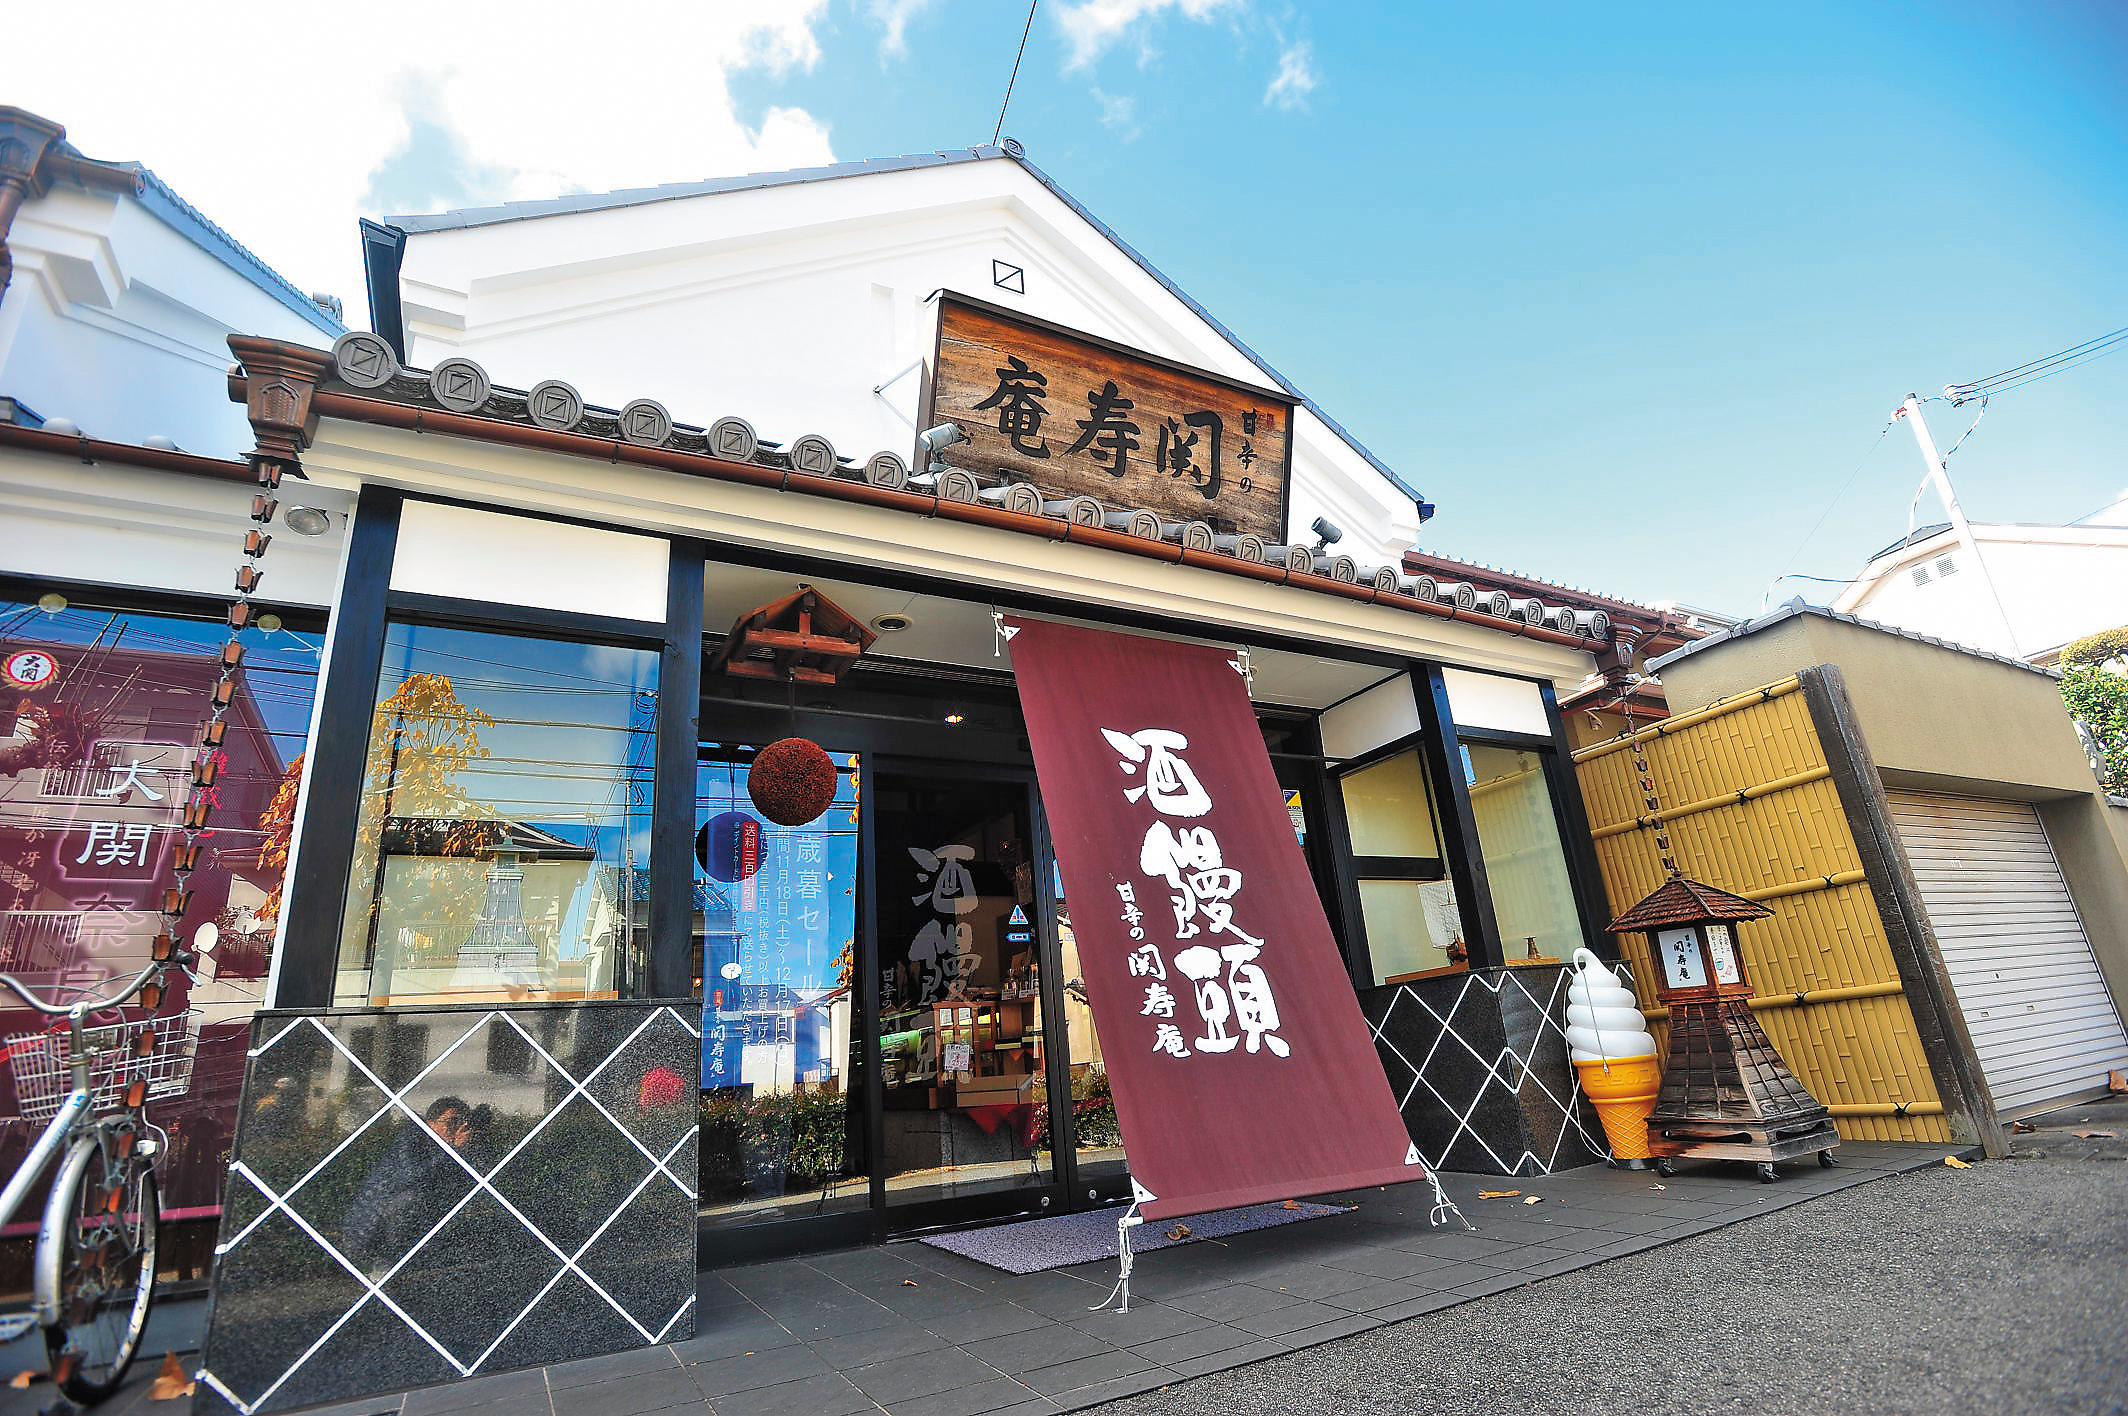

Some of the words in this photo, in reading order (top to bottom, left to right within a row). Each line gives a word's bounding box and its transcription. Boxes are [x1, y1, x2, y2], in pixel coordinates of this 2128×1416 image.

[1237, 408, 1258, 493] 甘辛の
[75, 759, 164, 867] 大関
[797, 820, 822, 992] 歳暮セール
[1100, 727, 1291, 1058] 酒饅頭
